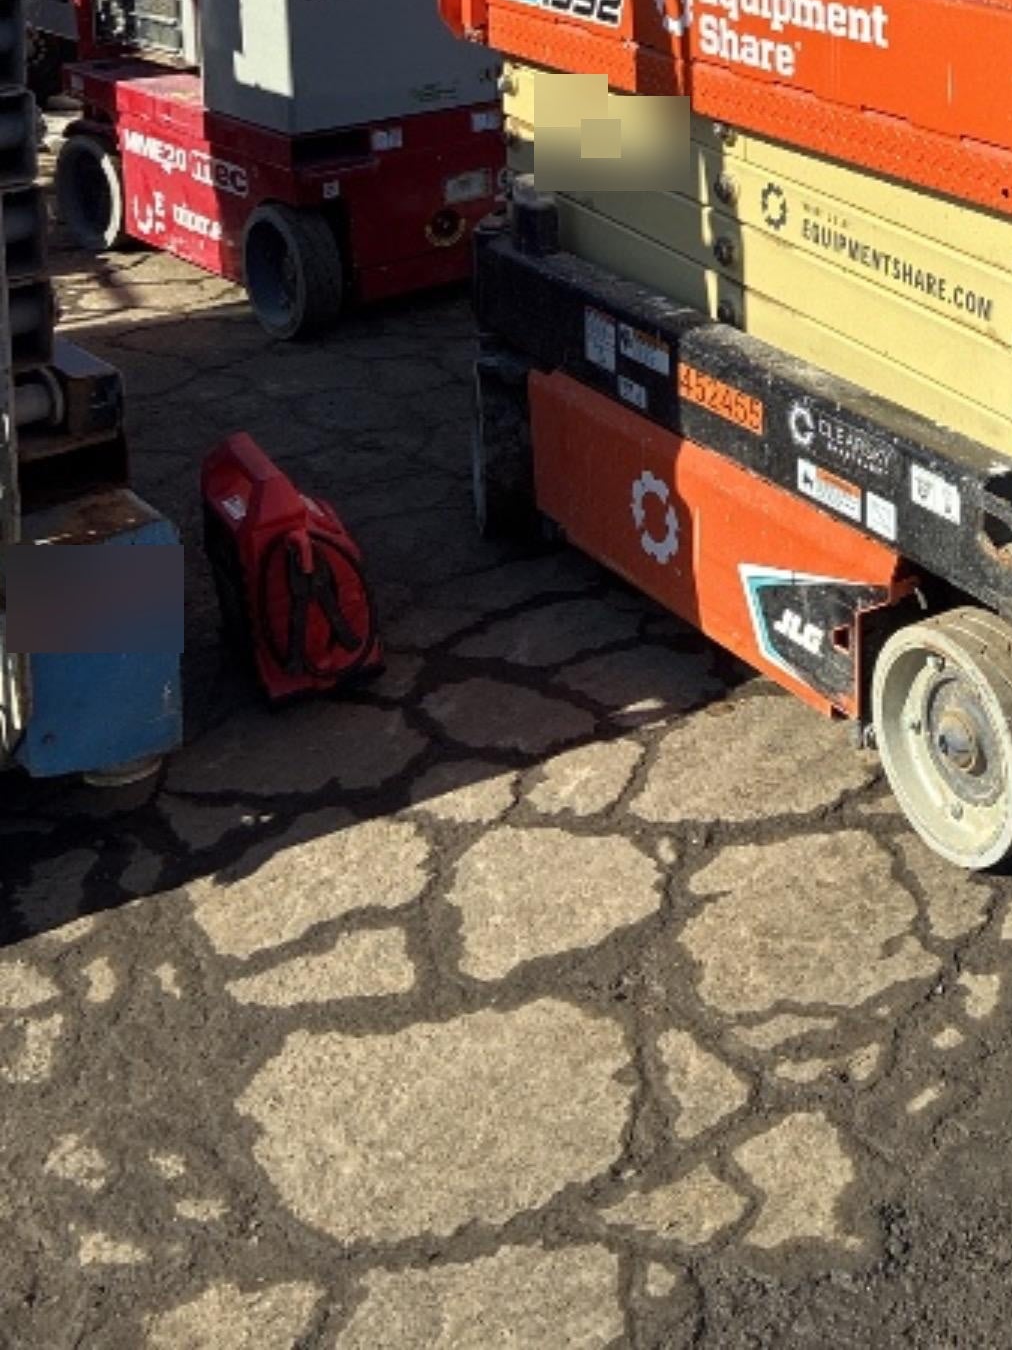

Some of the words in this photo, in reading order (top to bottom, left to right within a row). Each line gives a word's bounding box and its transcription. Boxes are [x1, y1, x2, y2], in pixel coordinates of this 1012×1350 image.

[700, 13, 796, 77] Share
[680, 366, 762, 430] 452455
[773, 608, 824, 656] JLG
